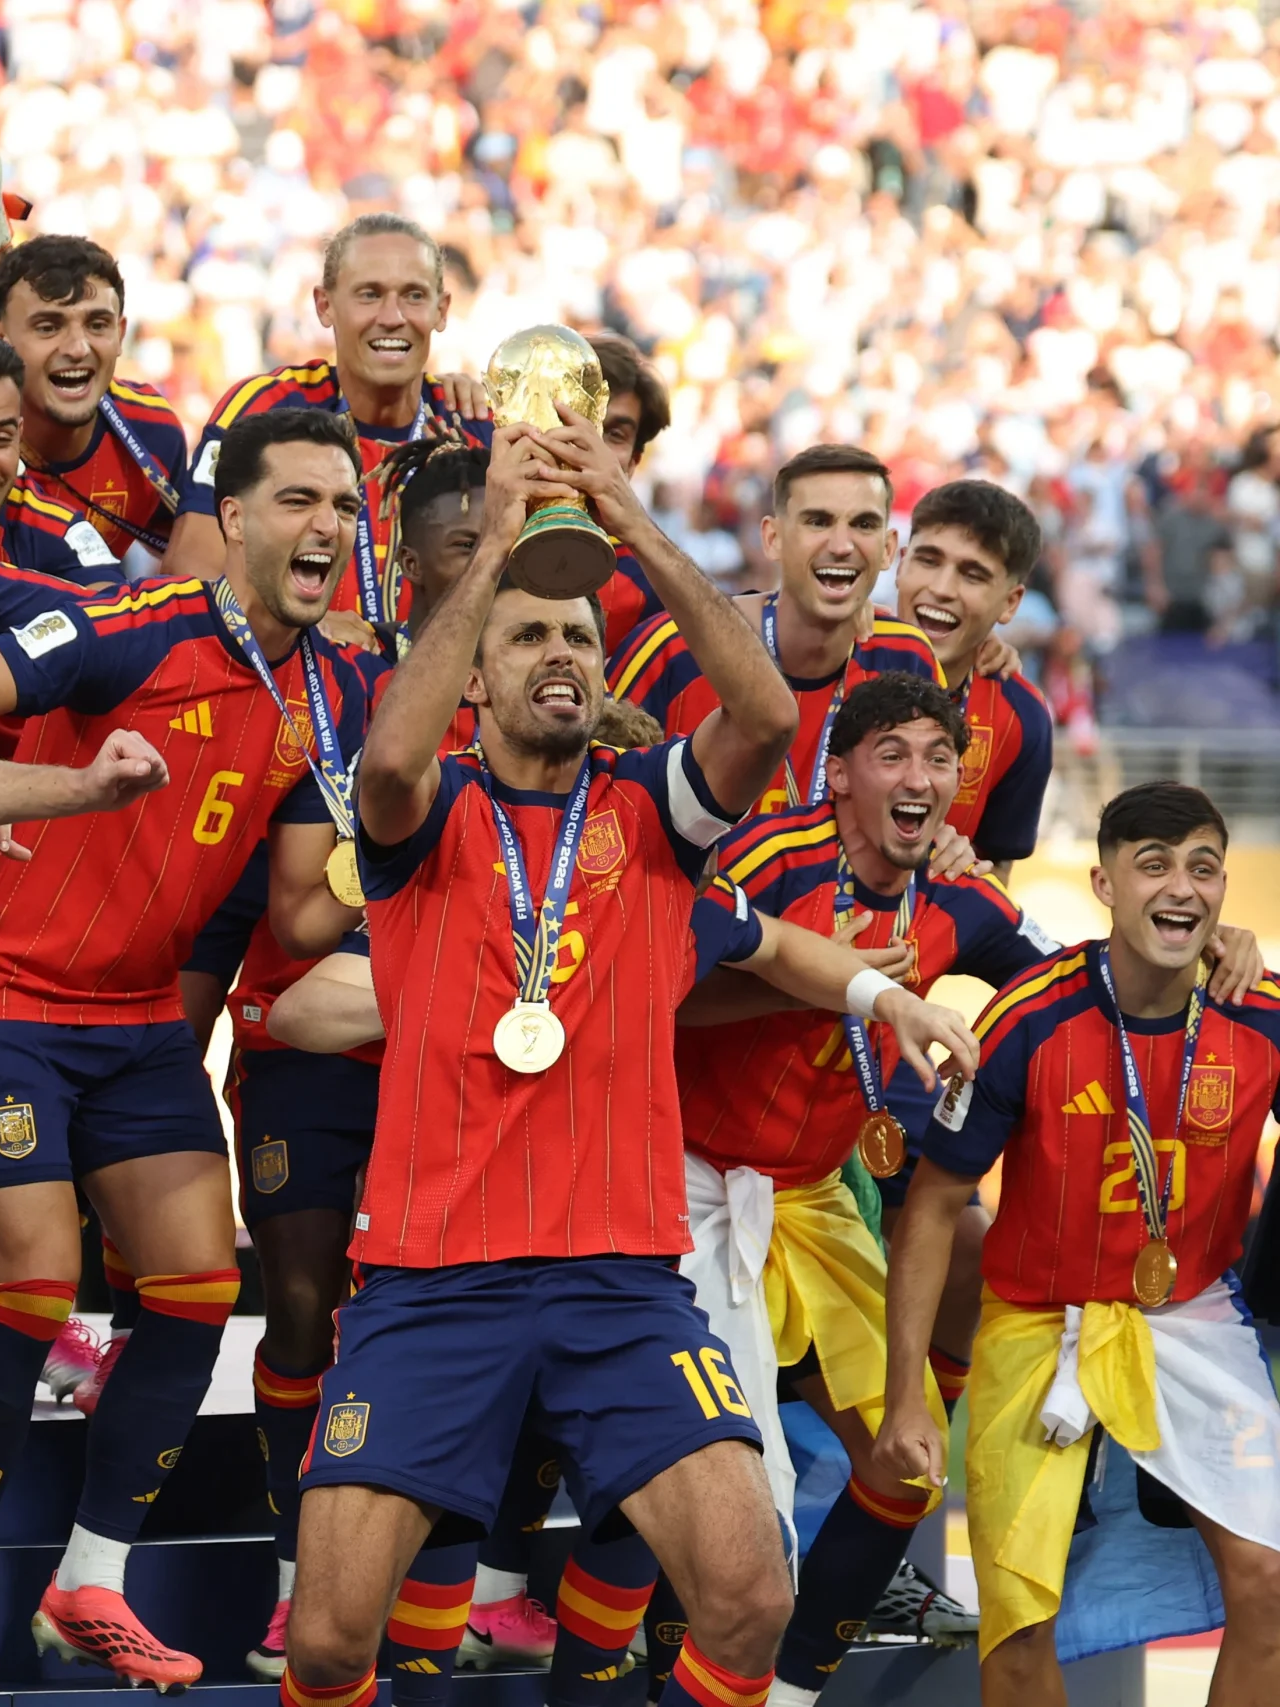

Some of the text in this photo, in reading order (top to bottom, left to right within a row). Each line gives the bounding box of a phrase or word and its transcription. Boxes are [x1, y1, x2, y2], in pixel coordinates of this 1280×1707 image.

[101, 401, 145, 460] FIFA WORLD
[358, 521, 368, 544] FIFA
[359, 543, 374, 588] WORLD
[365, 588, 378, 617] CUP
[251, 651, 284, 712] CUP 2026
[309, 673, 320, 694] CUP
[314, 692, 329, 730] WORLD
[321, 728, 334, 753] FIFA
[814, 768, 826, 792] CUP
[193, 770, 244, 845] 6
[553, 768, 593, 889] FIFA WORLD CUP 2026
[502, 824, 515, 850] CUP
[506, 846, 524, 894] WORLD
[517, 892, 527, 920] FIFA
[850, 1025, 879, 1112] FIFA WORLD CU
[1122, 1033, 1140, 1098] CUP 2026
[1181, 1055, 1193, 1082] FIFA
[1098, 1138, 1187, 1213] 20
[669, 1347, 751, 1420] 16
